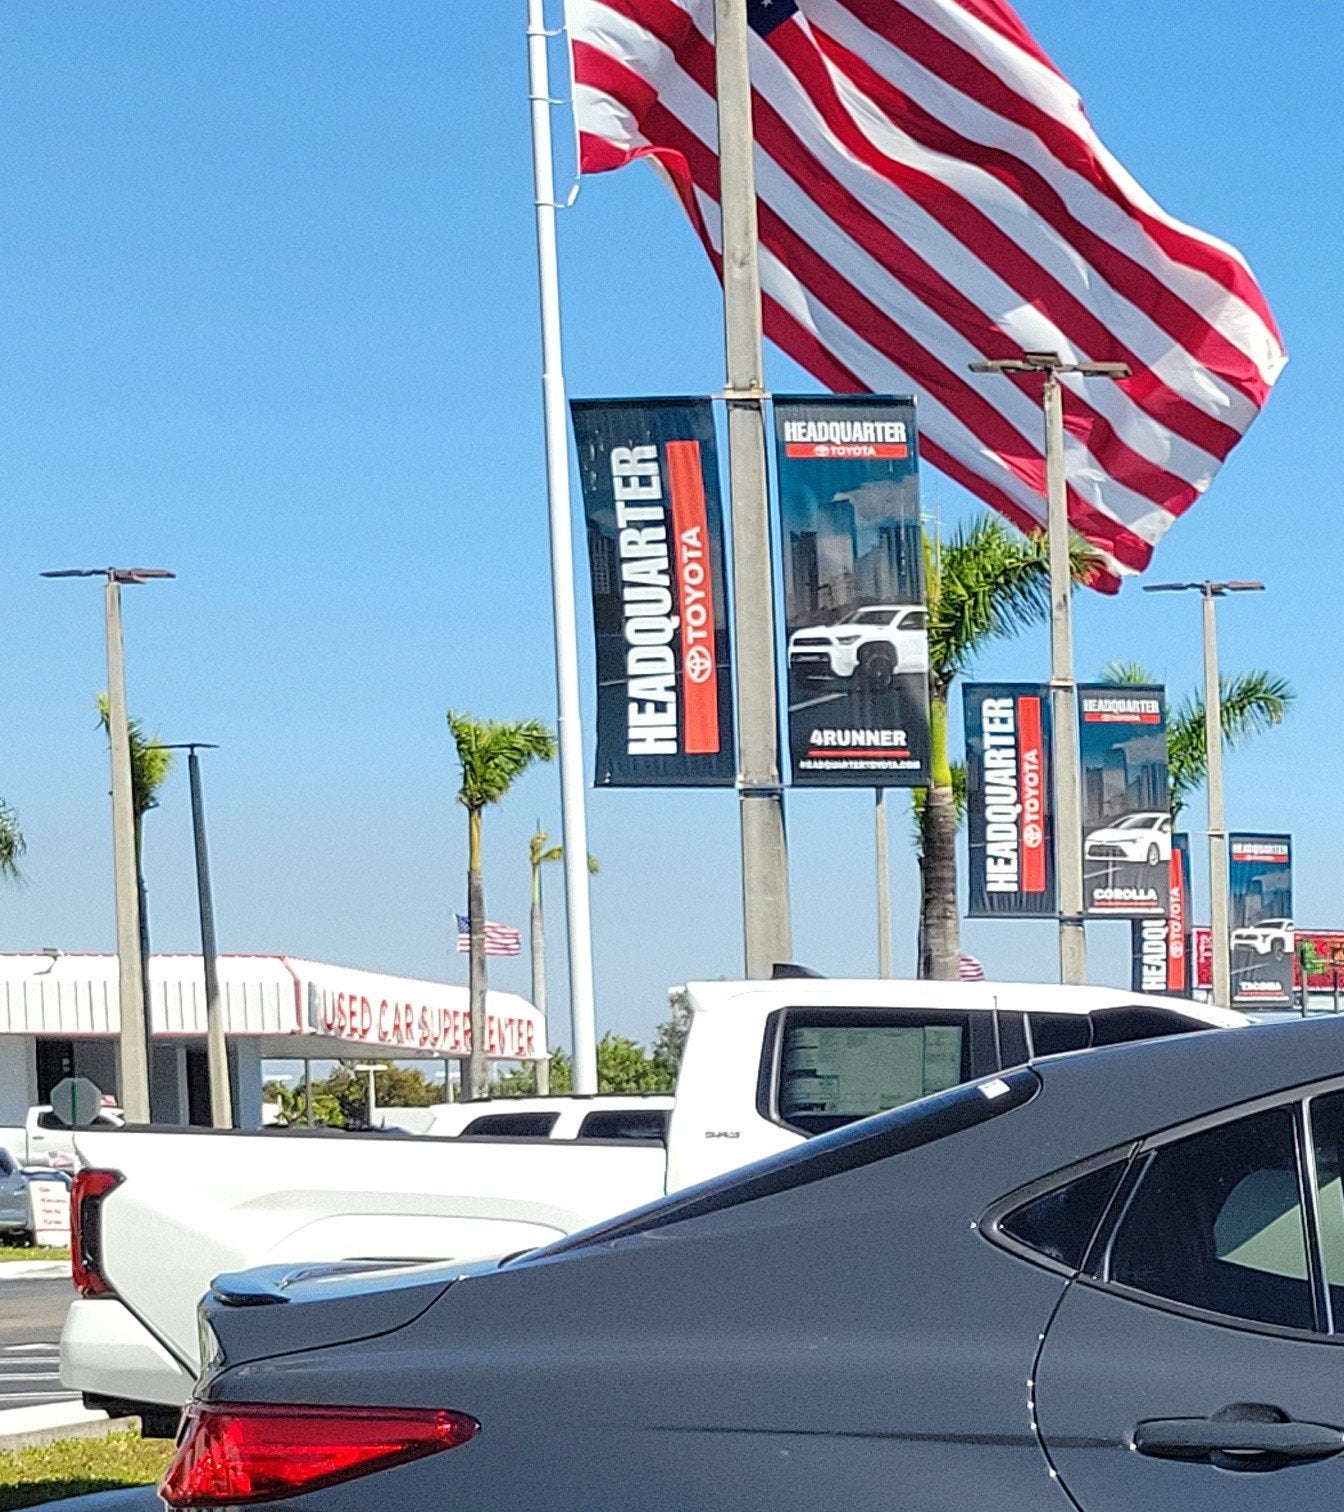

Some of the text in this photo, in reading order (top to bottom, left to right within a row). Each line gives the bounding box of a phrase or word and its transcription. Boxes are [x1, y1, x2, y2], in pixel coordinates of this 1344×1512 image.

[785, 421, 907, 443] HEADQUARTER
[830, 446, 877, 457] TOYOTA
[611, 444, 680, 756] HEADQUARTER
[681, 526, 708, 644] TOYOTA
[810, 729, 907, 747] 4RUNNER
[1083, 699, 1160, 714] HEADQUARTER
[982, 698, 1022, 892] HEADQUARTER
[1023, 748, 1040, 823] TOYOTA
[1092, 888, 1158, 901] COROLLA
[1141, 918, 1169, 990] HEADQU
[323, 989, 534, 1055] USED CAR SUPERENTER
